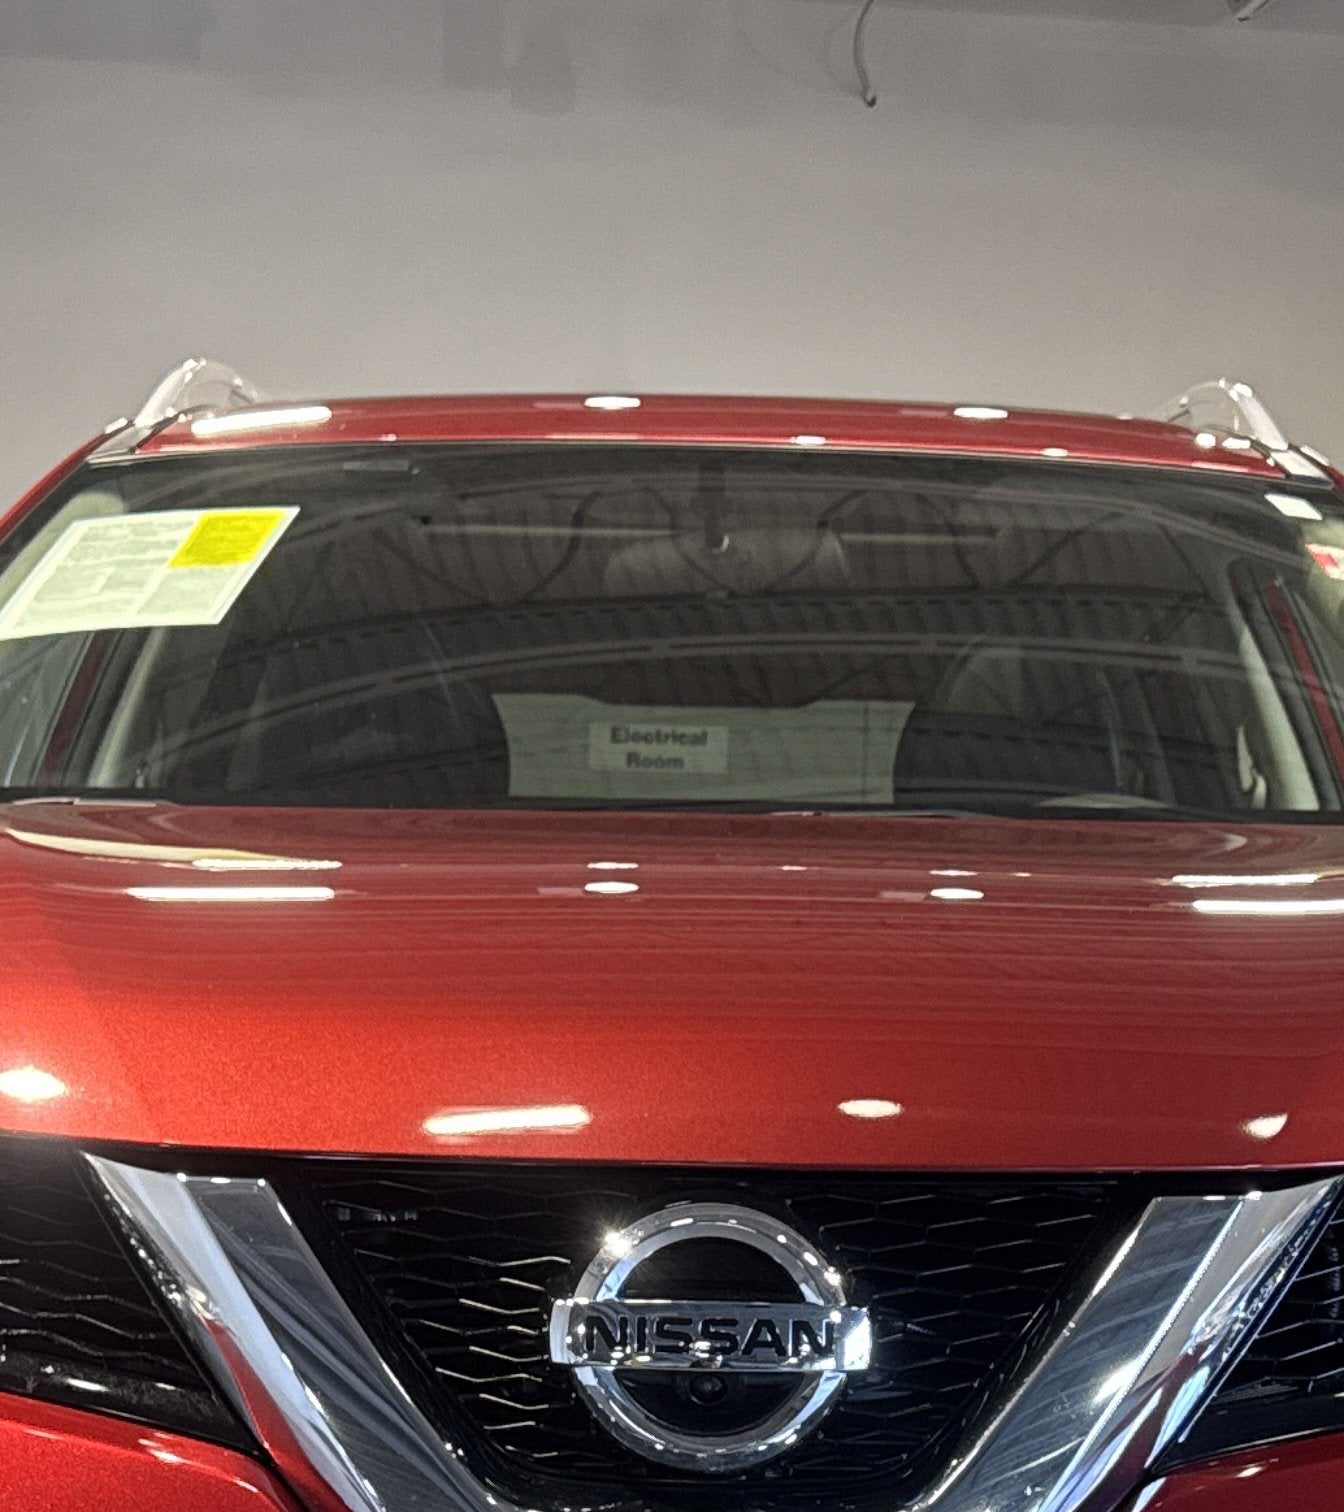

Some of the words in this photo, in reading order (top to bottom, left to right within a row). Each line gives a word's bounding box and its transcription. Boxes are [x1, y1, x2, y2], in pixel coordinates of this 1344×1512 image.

[610, 725, 708, 747] Electrical
[626, 751, 685, 770] Room
[585, 1315, 835, 1358] NISSAN
